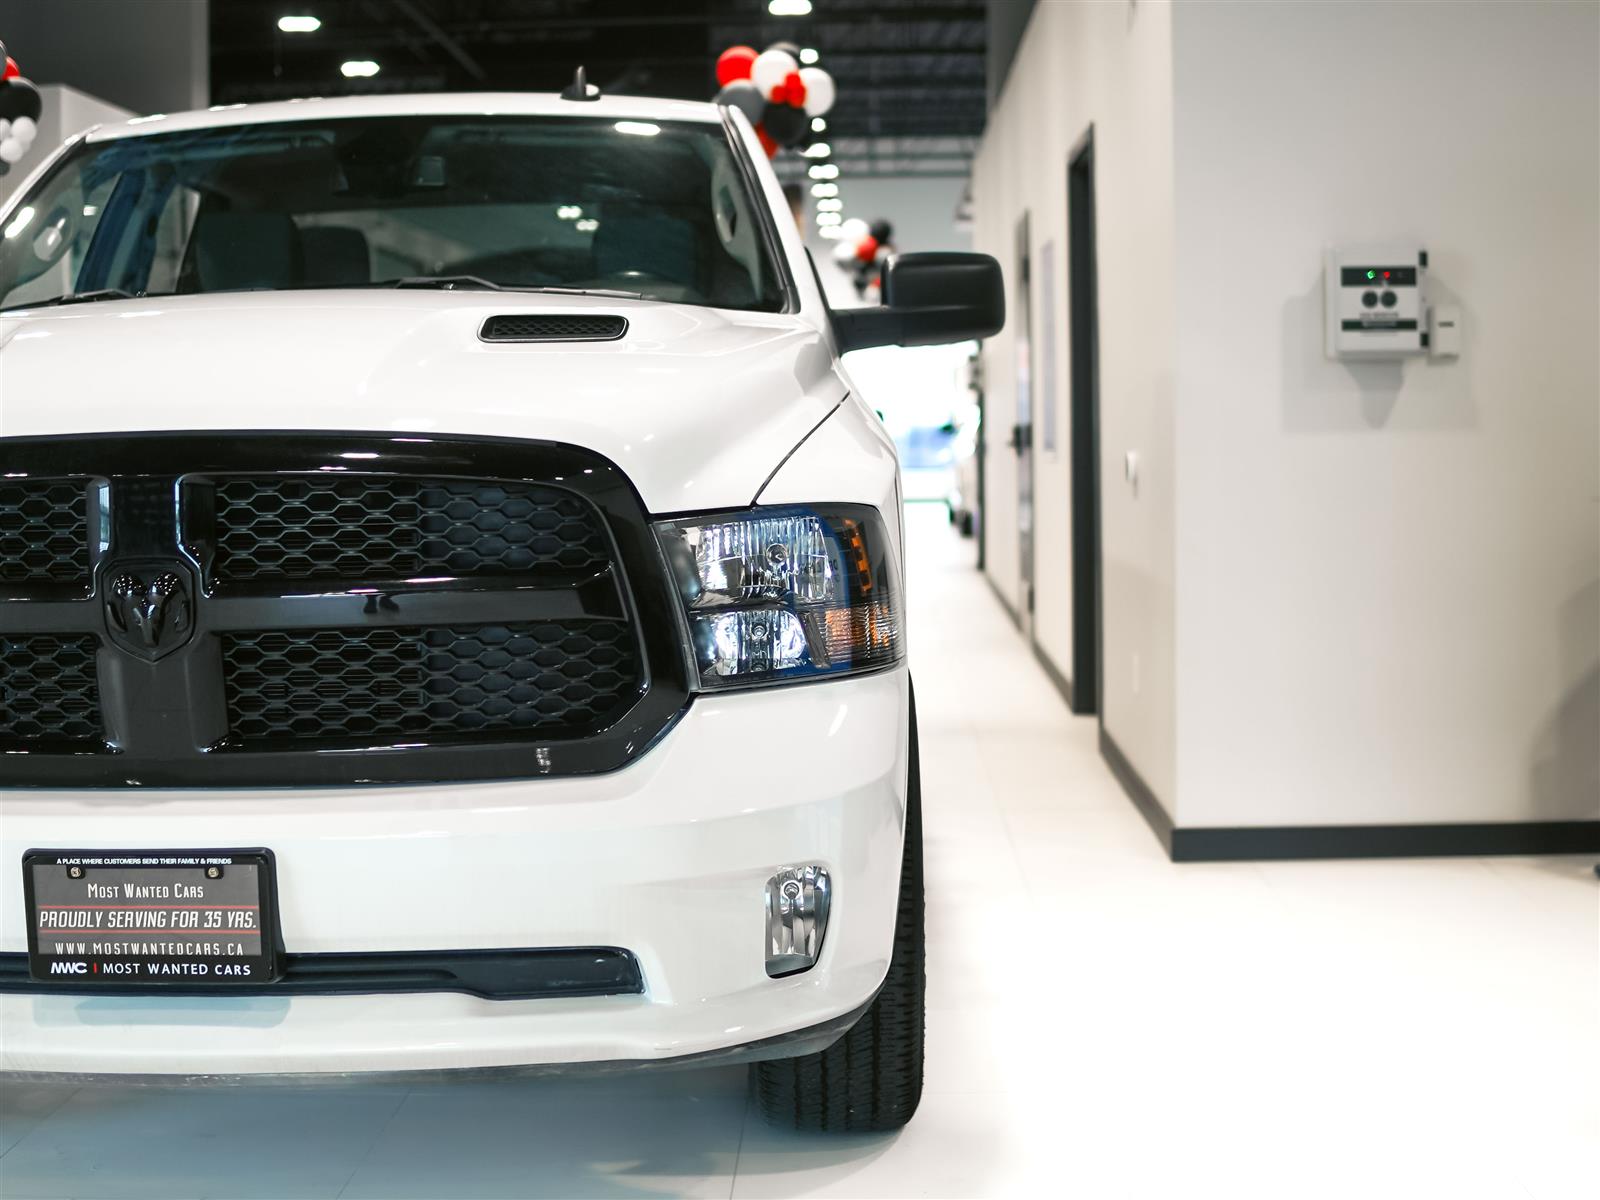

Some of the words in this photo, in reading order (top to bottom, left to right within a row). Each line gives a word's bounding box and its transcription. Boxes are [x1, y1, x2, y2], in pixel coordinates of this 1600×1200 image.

[39, 911, 103, 928] PROUDLY
[107, 911, 167, 928] SERVING
[170, 911, 199, 928] FOR
[203, 911, 222, 928] 35
[227, 911, 257, 928] YRS.
[55, 942, 244, 956] WWW.MOSTWANTEDCARS.CA
[50, 962, 88, 974] MWC
[103, 963, 140, 974] MOST
[147, 963, 208, 975] WANTED
[214, 964, 251, 976] CARS
